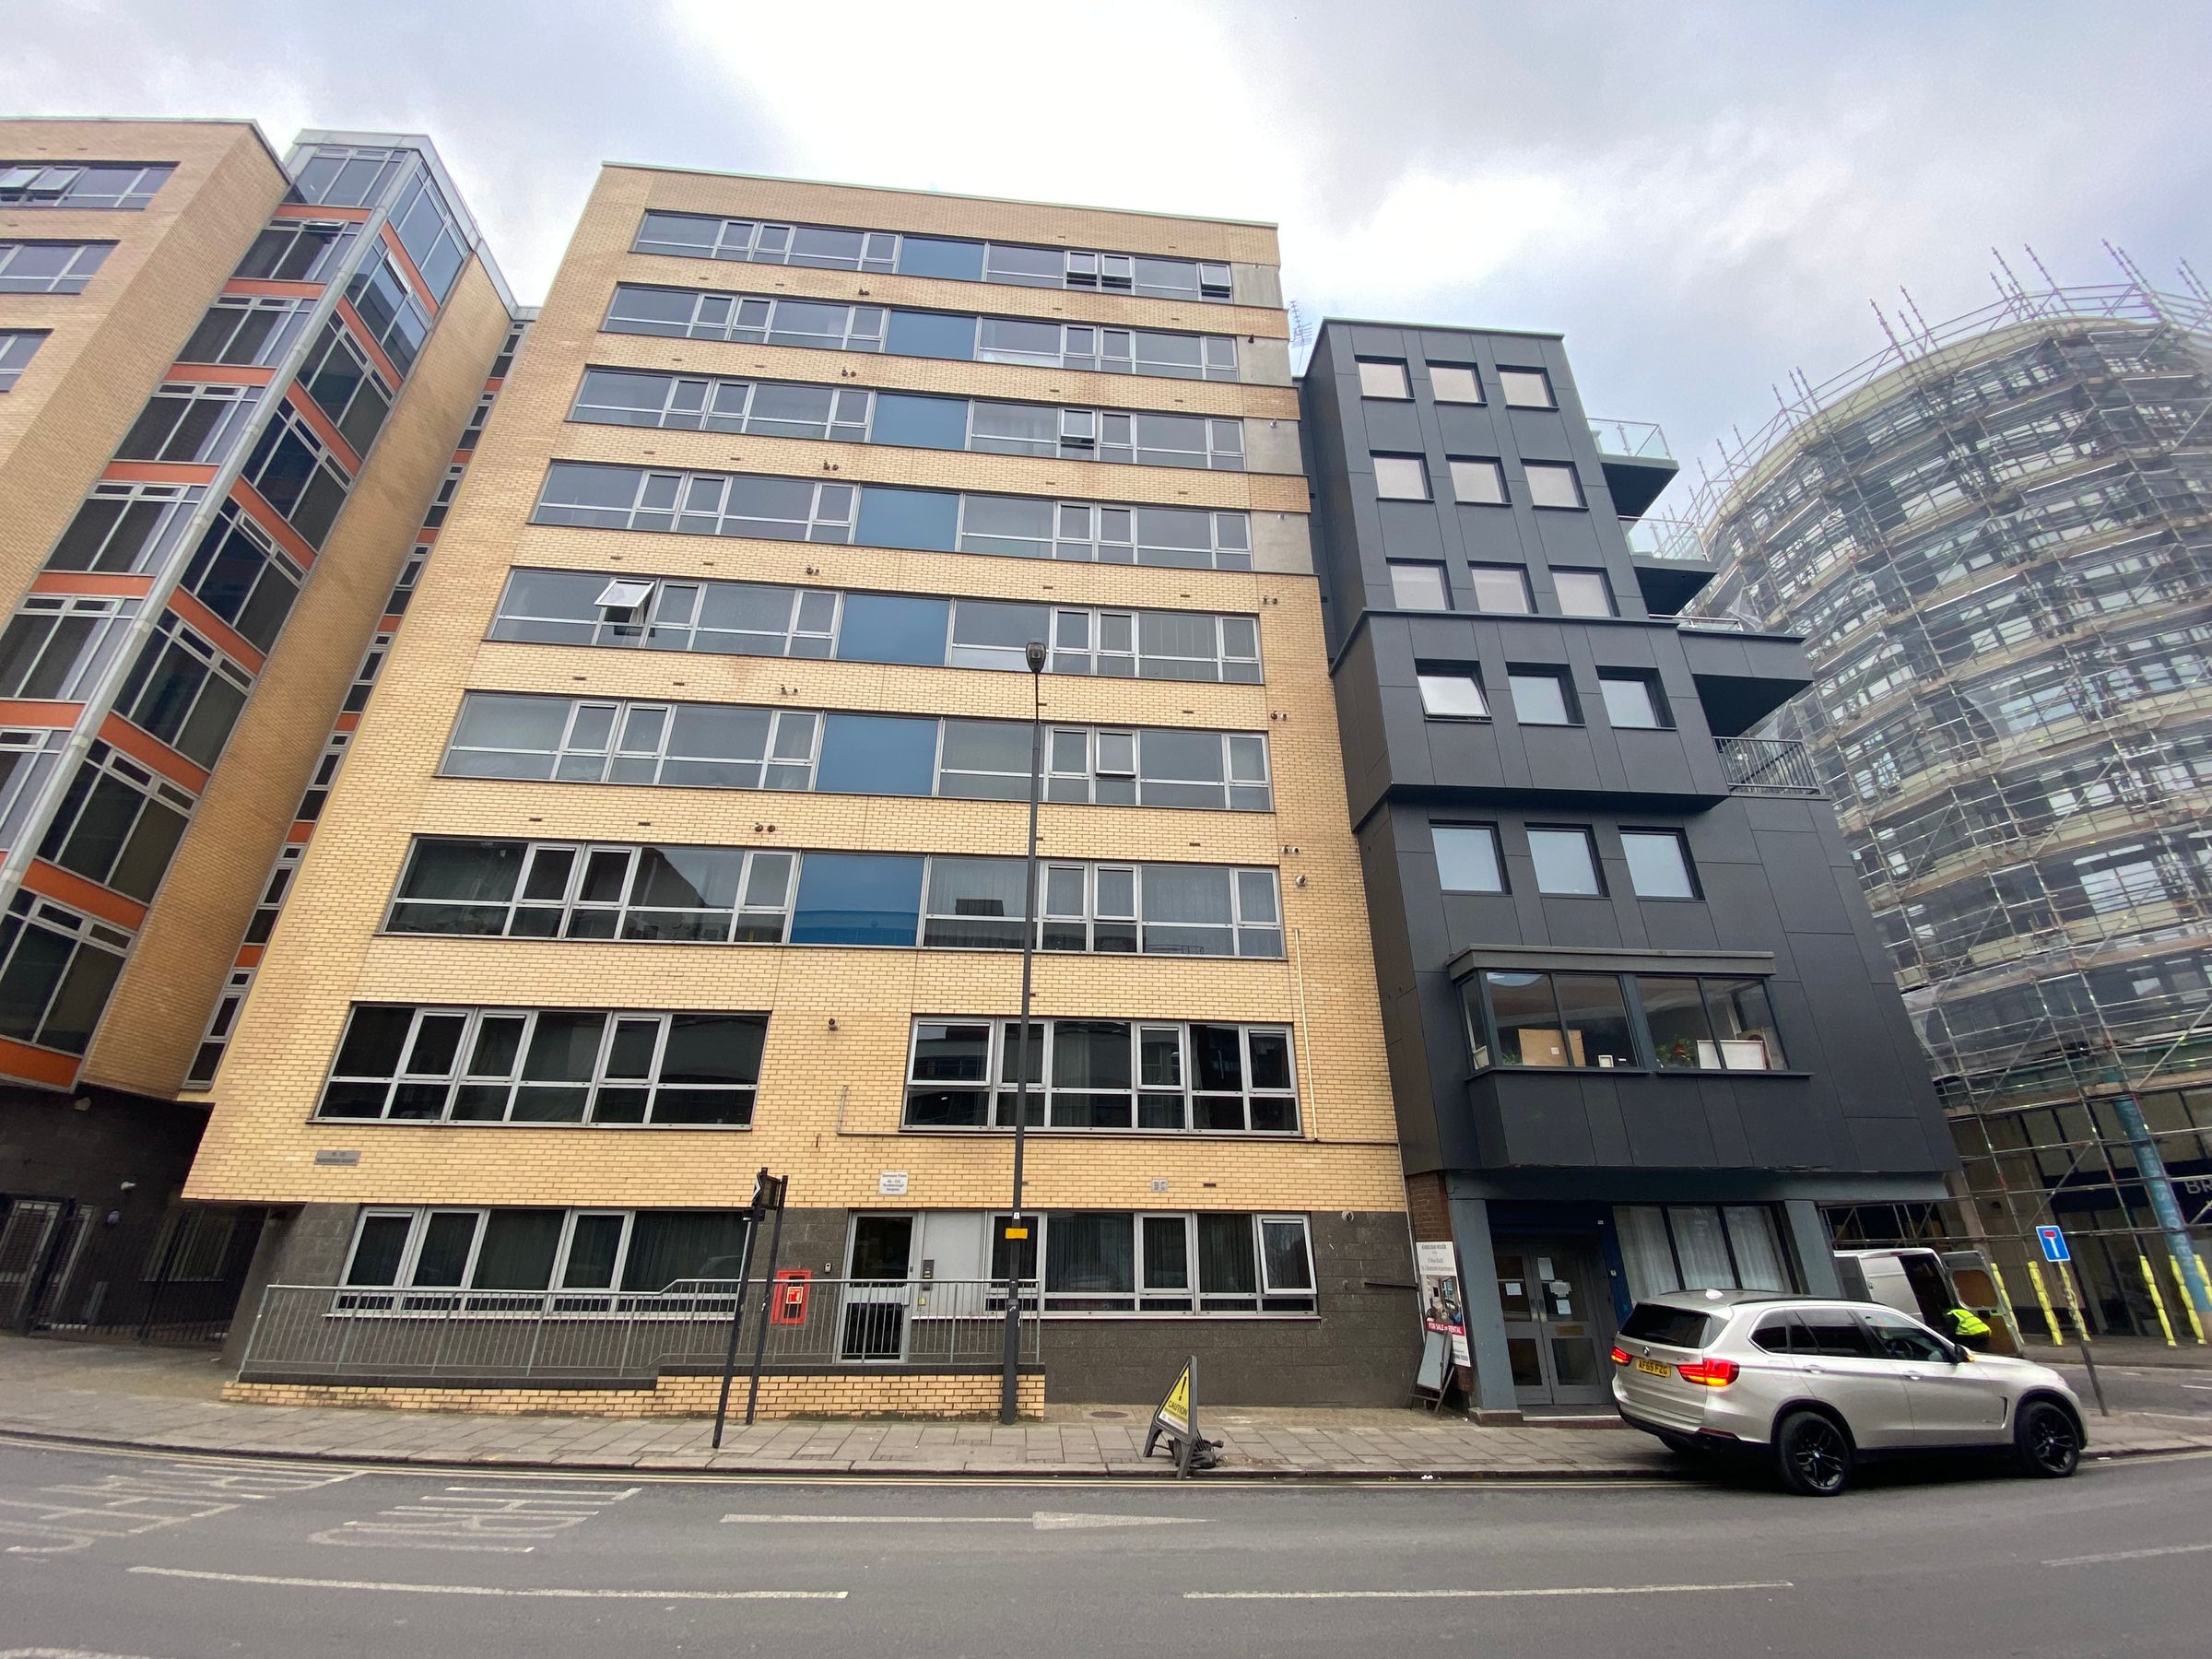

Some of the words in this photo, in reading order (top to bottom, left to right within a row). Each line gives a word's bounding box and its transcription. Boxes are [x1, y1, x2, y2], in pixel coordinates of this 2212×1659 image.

[1639, 1359, 1654, 1371] AF65
[1654, 1365, 1668, 1375] FZG
[1168, 1400, 1188, 1416] CAUTION
